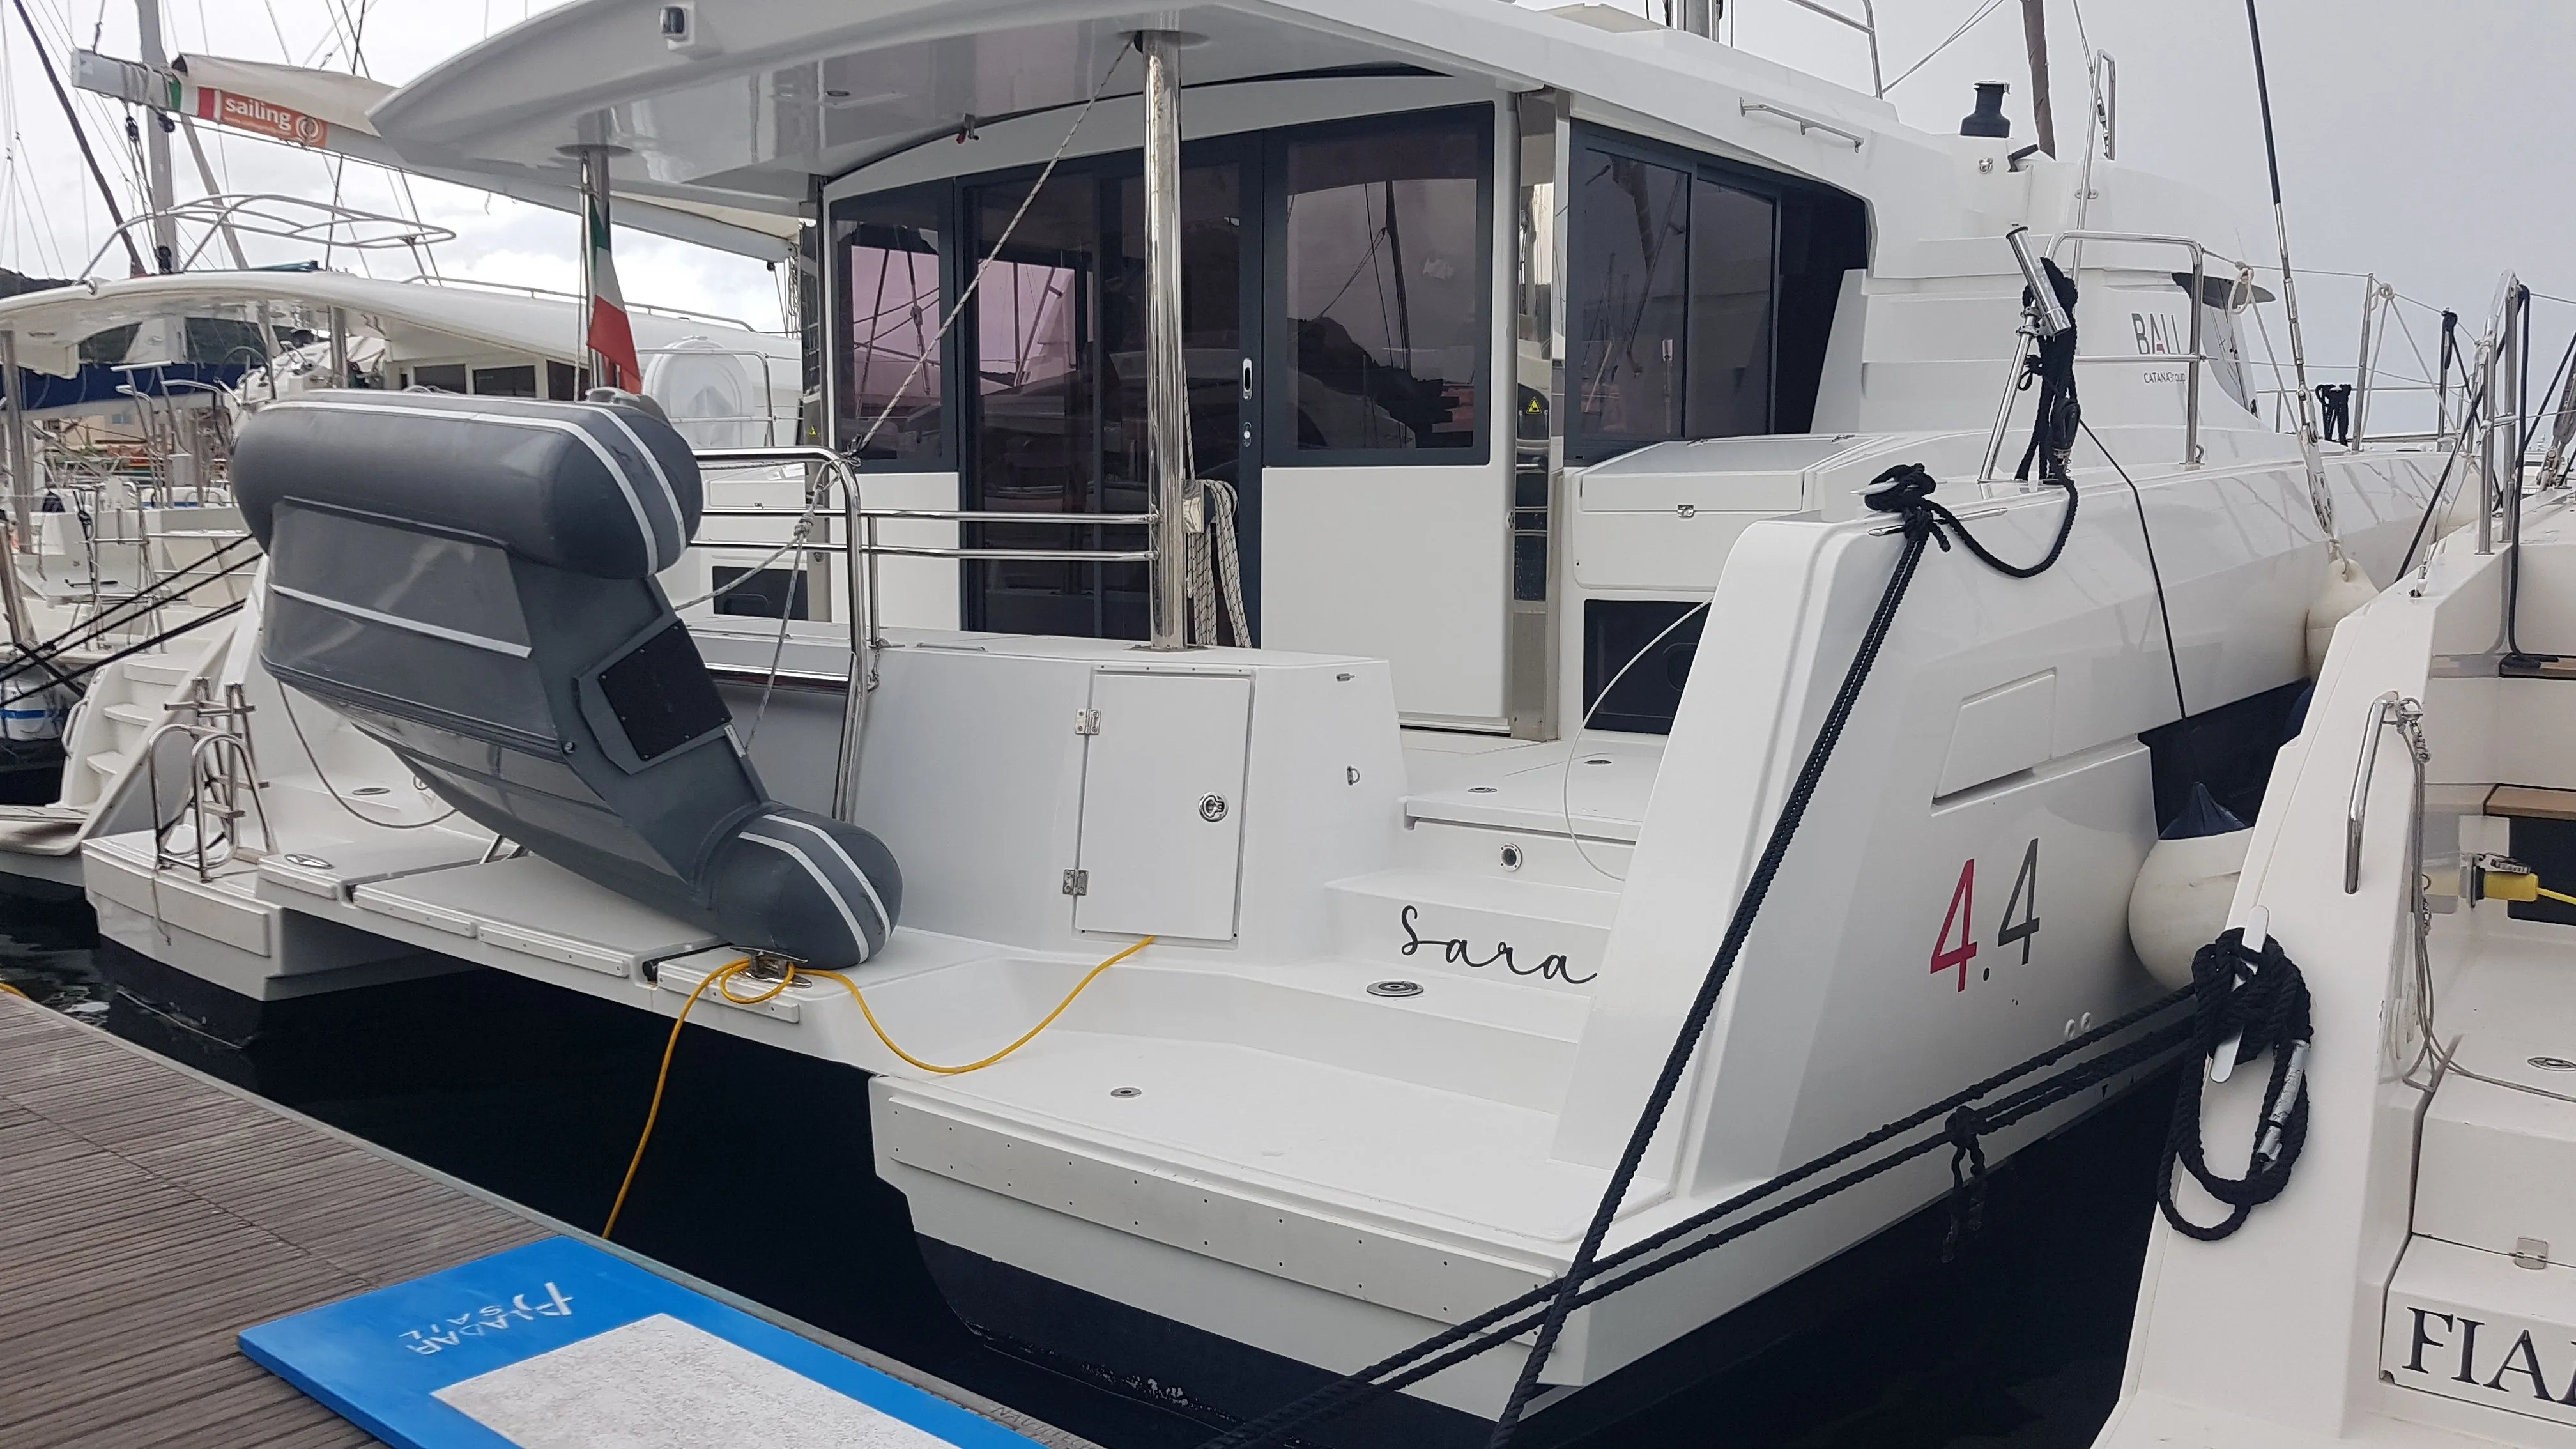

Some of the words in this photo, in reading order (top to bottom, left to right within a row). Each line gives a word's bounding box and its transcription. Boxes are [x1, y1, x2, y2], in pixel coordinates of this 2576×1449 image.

[225, 98, 292, 131] sailing
[1930, 838, 2040, 992] 4.4
[1401, 905, 1597, 984] Sara
[399, 1305, 502, 1340] SAIL
